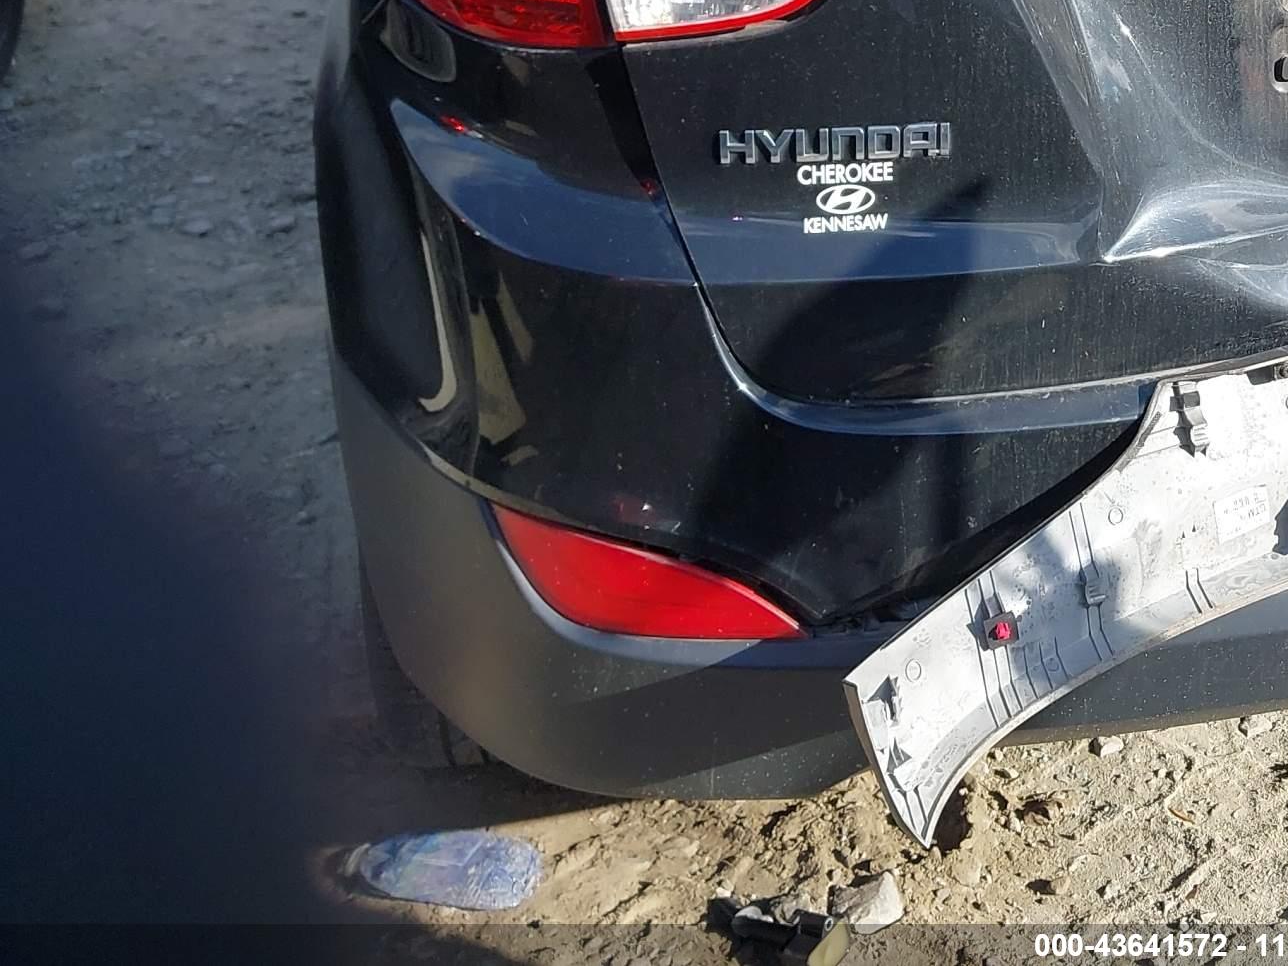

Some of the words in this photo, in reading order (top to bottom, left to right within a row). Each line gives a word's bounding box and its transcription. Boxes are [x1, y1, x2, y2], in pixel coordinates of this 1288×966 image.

[719, 122, 951, 164] HYUNDAI
[797, 162, 893, 185] CHEROKEE
[803, 213, 888, 234] KENNESAW
